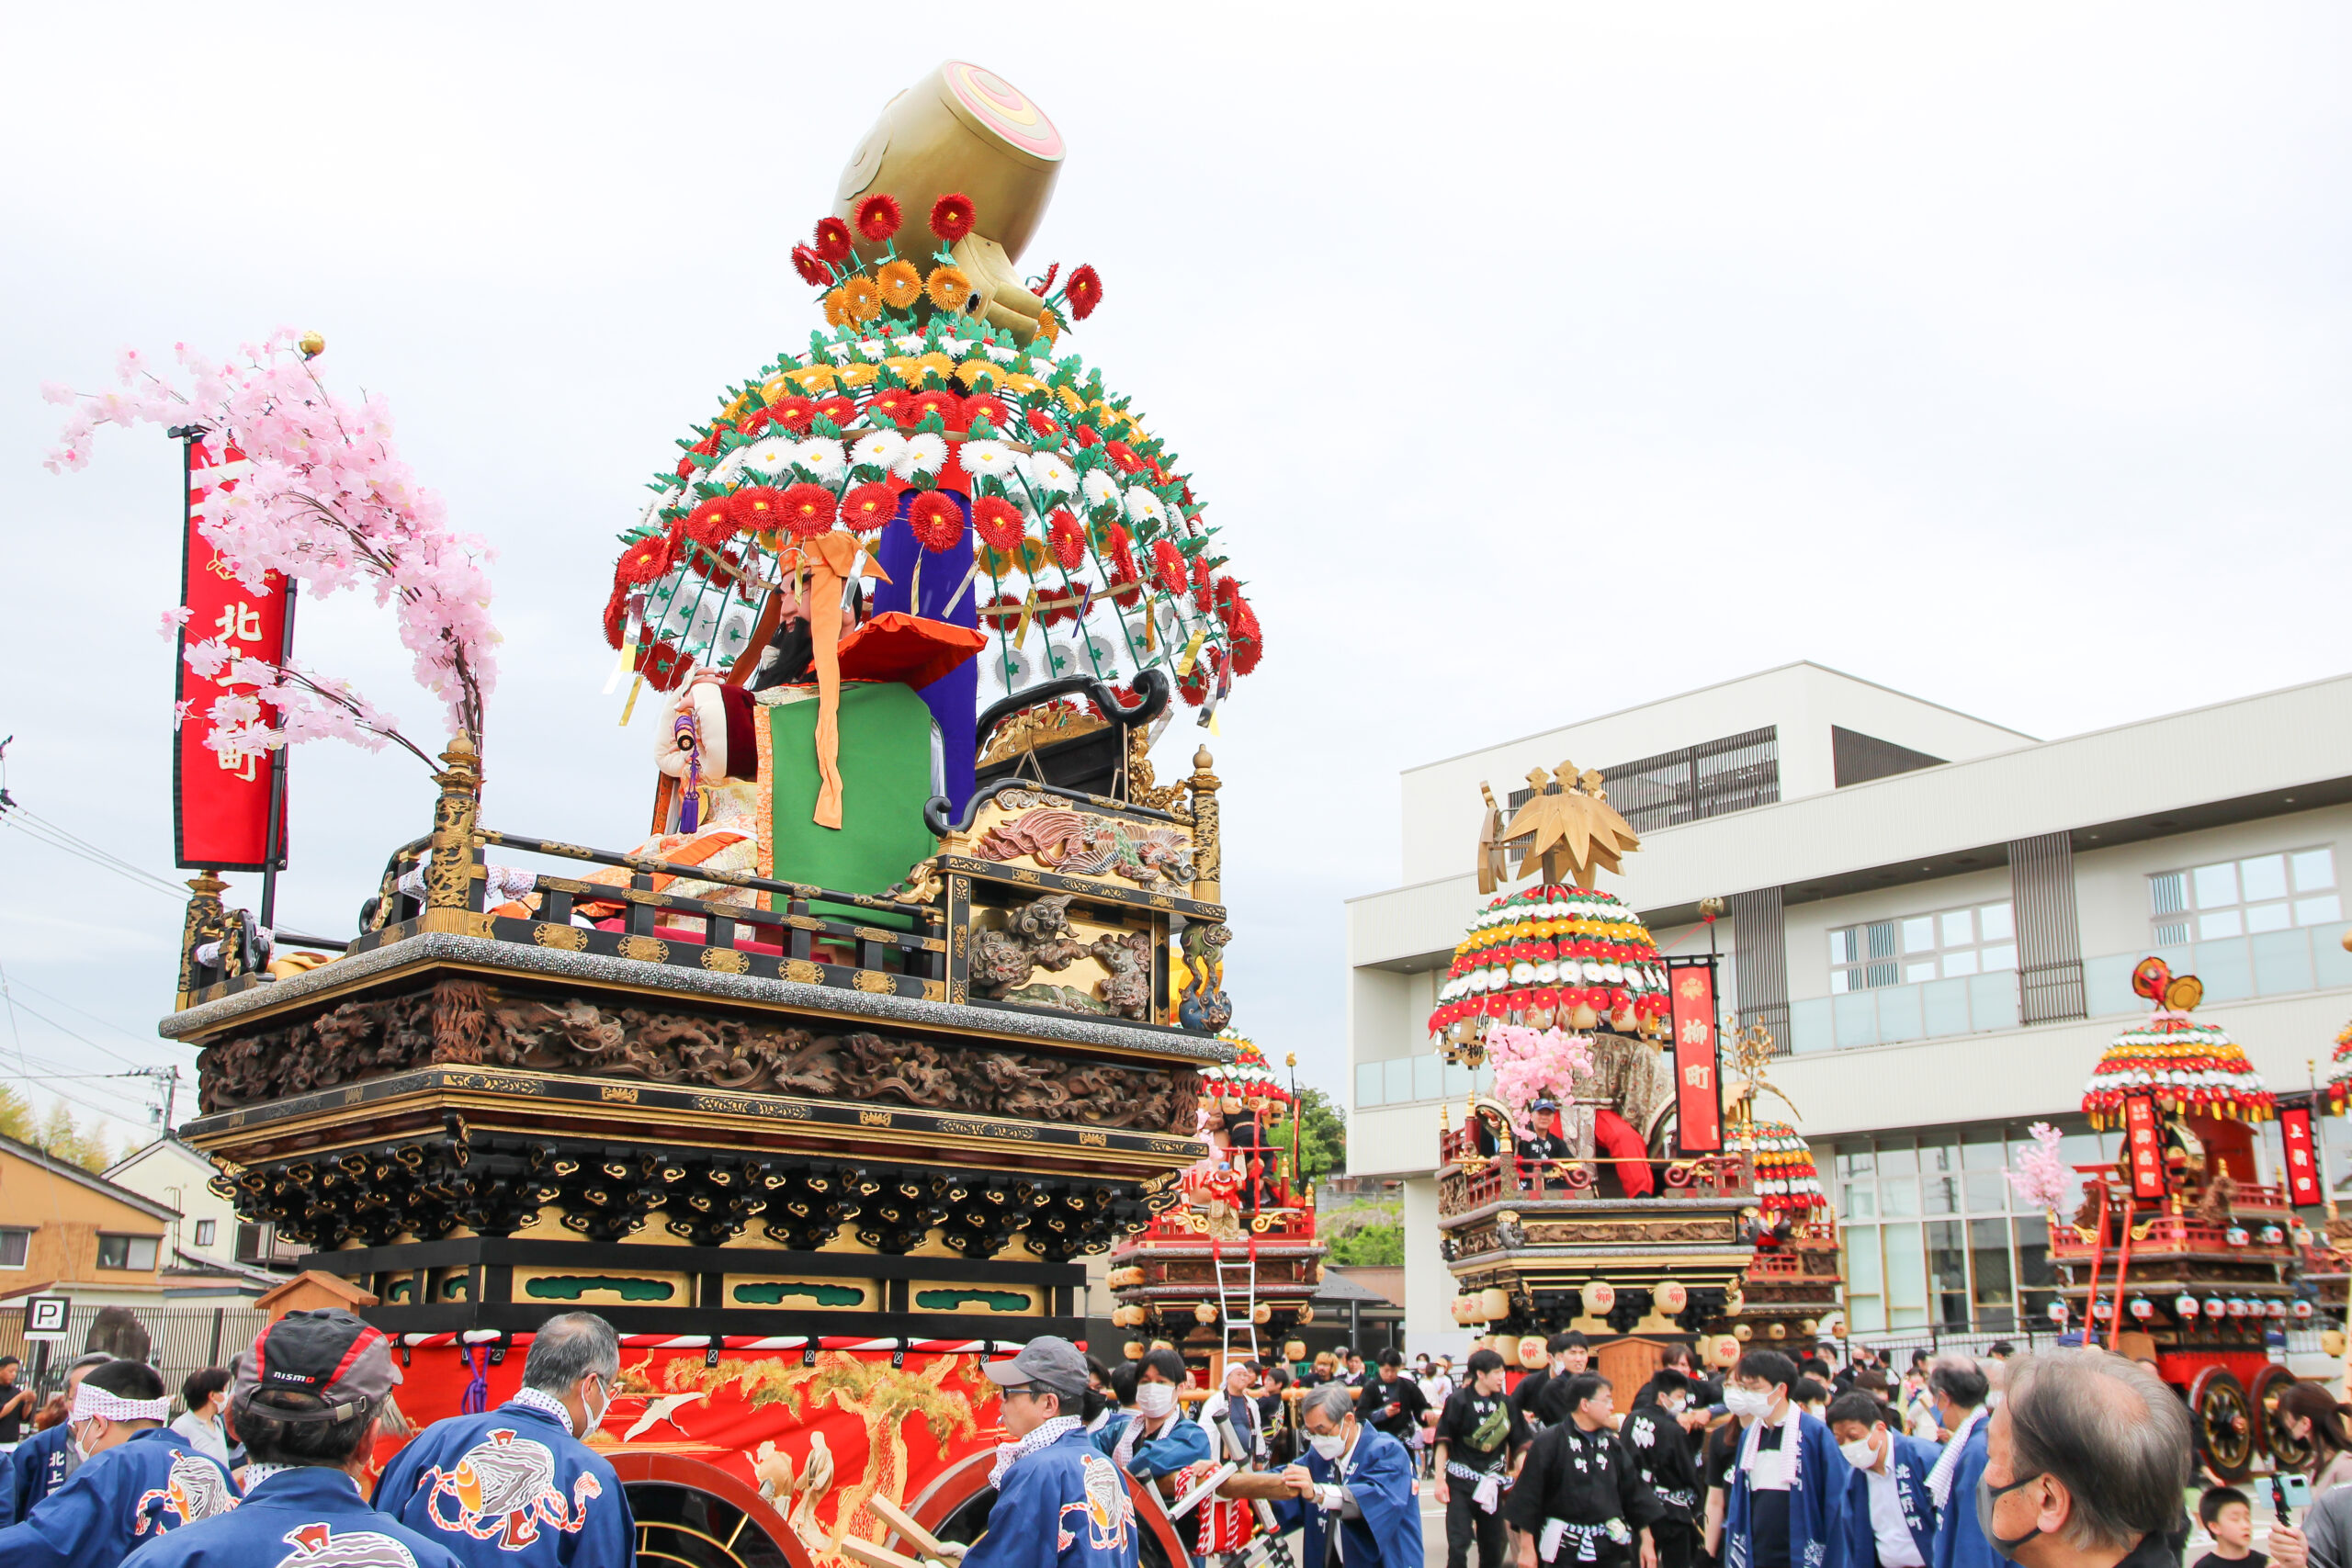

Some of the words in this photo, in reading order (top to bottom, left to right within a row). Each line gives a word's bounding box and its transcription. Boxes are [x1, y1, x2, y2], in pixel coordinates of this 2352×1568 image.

[1681, 1019, 1711, 1089] 柳町
[38, 1304, 58, 1325] P
[47, 1450, 65, 1496] 北上
